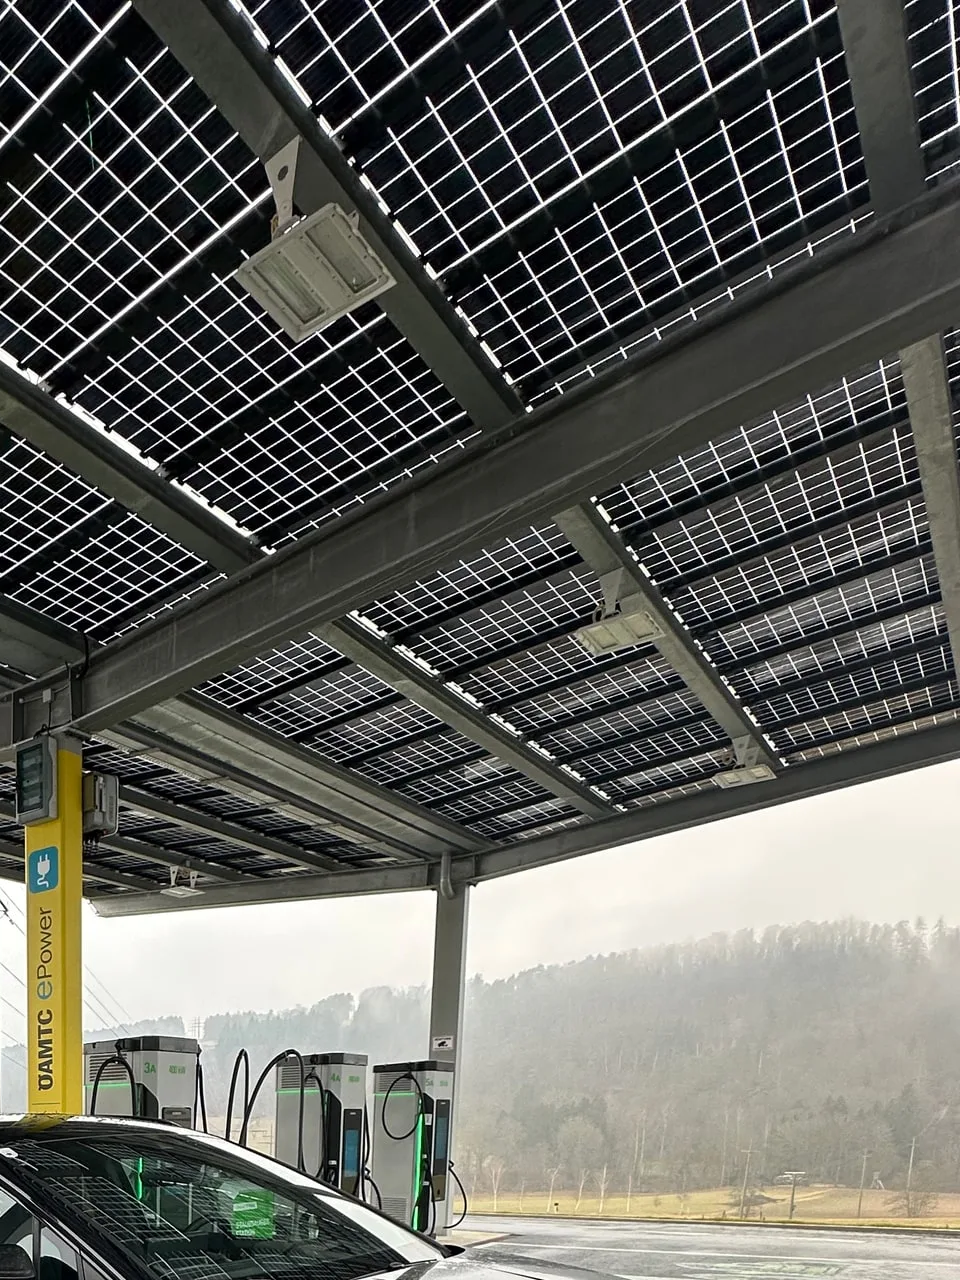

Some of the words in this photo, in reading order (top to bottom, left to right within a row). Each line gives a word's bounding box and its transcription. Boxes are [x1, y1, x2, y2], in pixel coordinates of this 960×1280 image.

[36, 906, 53, 1000] ePower
[37, 1009, 54, 1091] ÖAMTC
[144, 1062, 156, 1074] 3A
